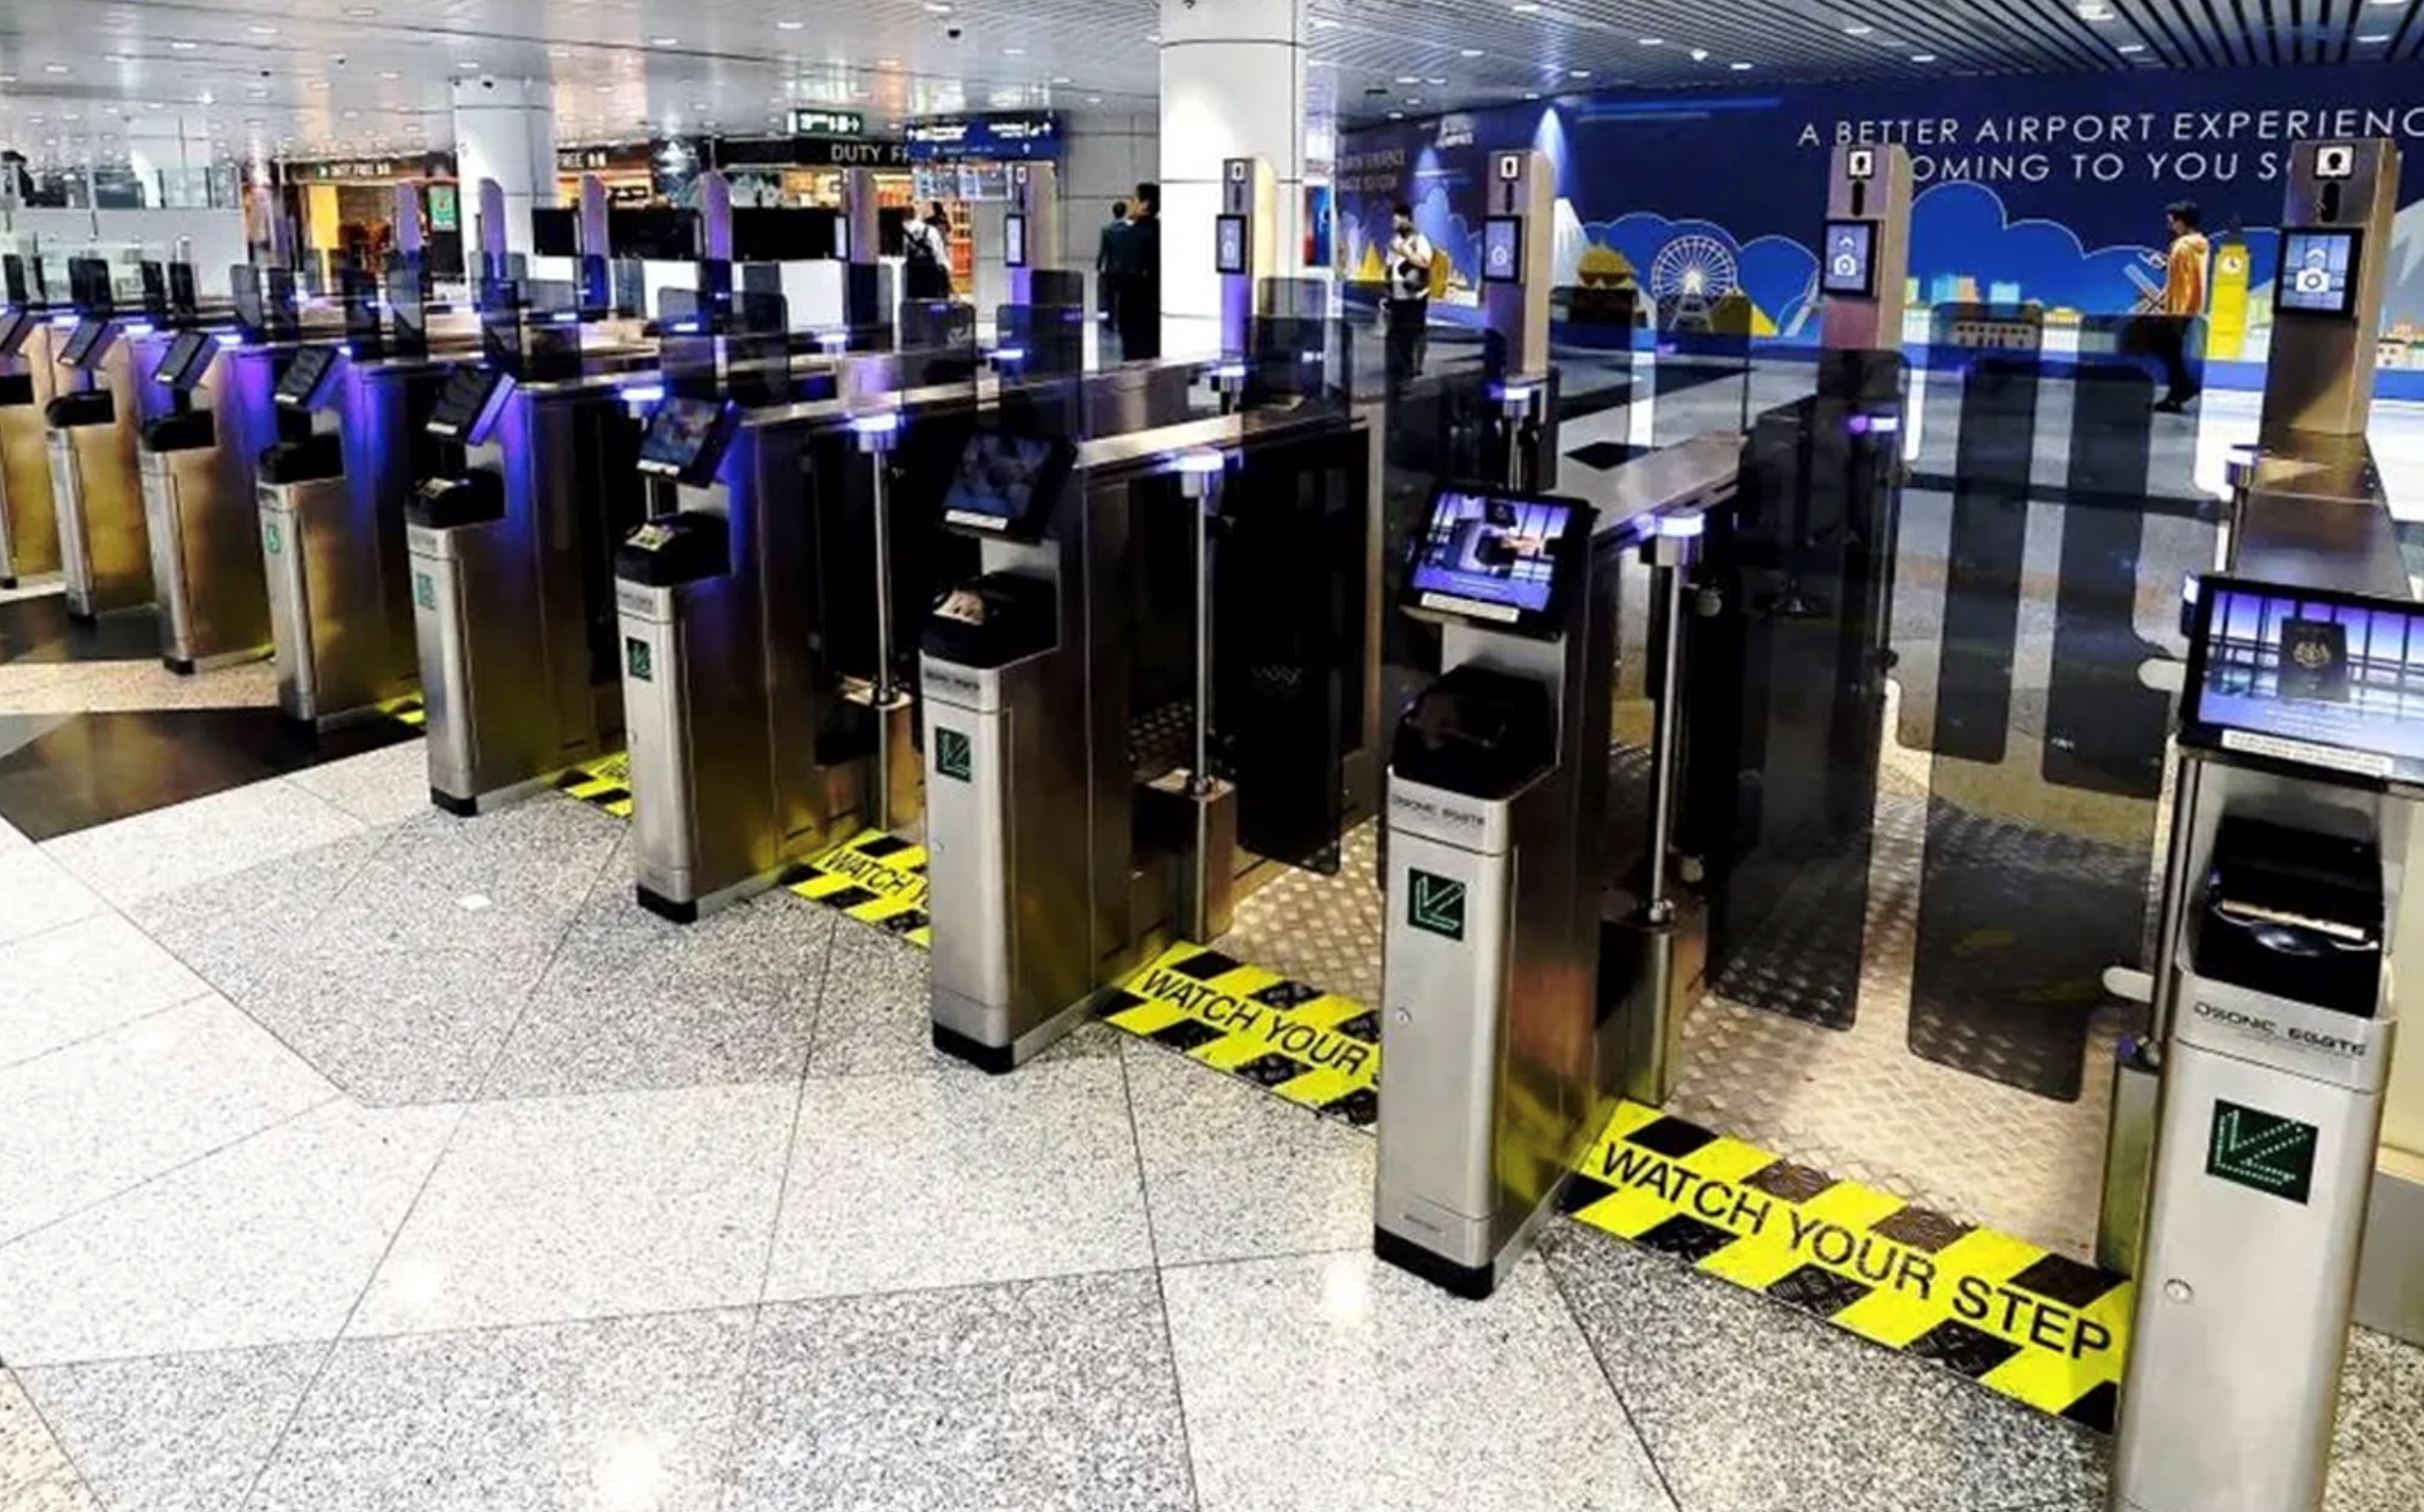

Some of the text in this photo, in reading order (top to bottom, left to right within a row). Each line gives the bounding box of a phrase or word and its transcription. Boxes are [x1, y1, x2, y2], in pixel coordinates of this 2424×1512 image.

[1797, 106, 2424, 147] A BETTER AIRPORT EXPERIENC
[830, 144, 882, 163] DUTY
[1910, 153, 2051, 182] OMING
[2071, 152, 2125, 182] TO
[2146, 151, 2239, 182] YOU
[1141, 968, 1371, 1077] WATCH YOUR
[1602, 1141, 2112, 1360] WATCH YOUR STEP
